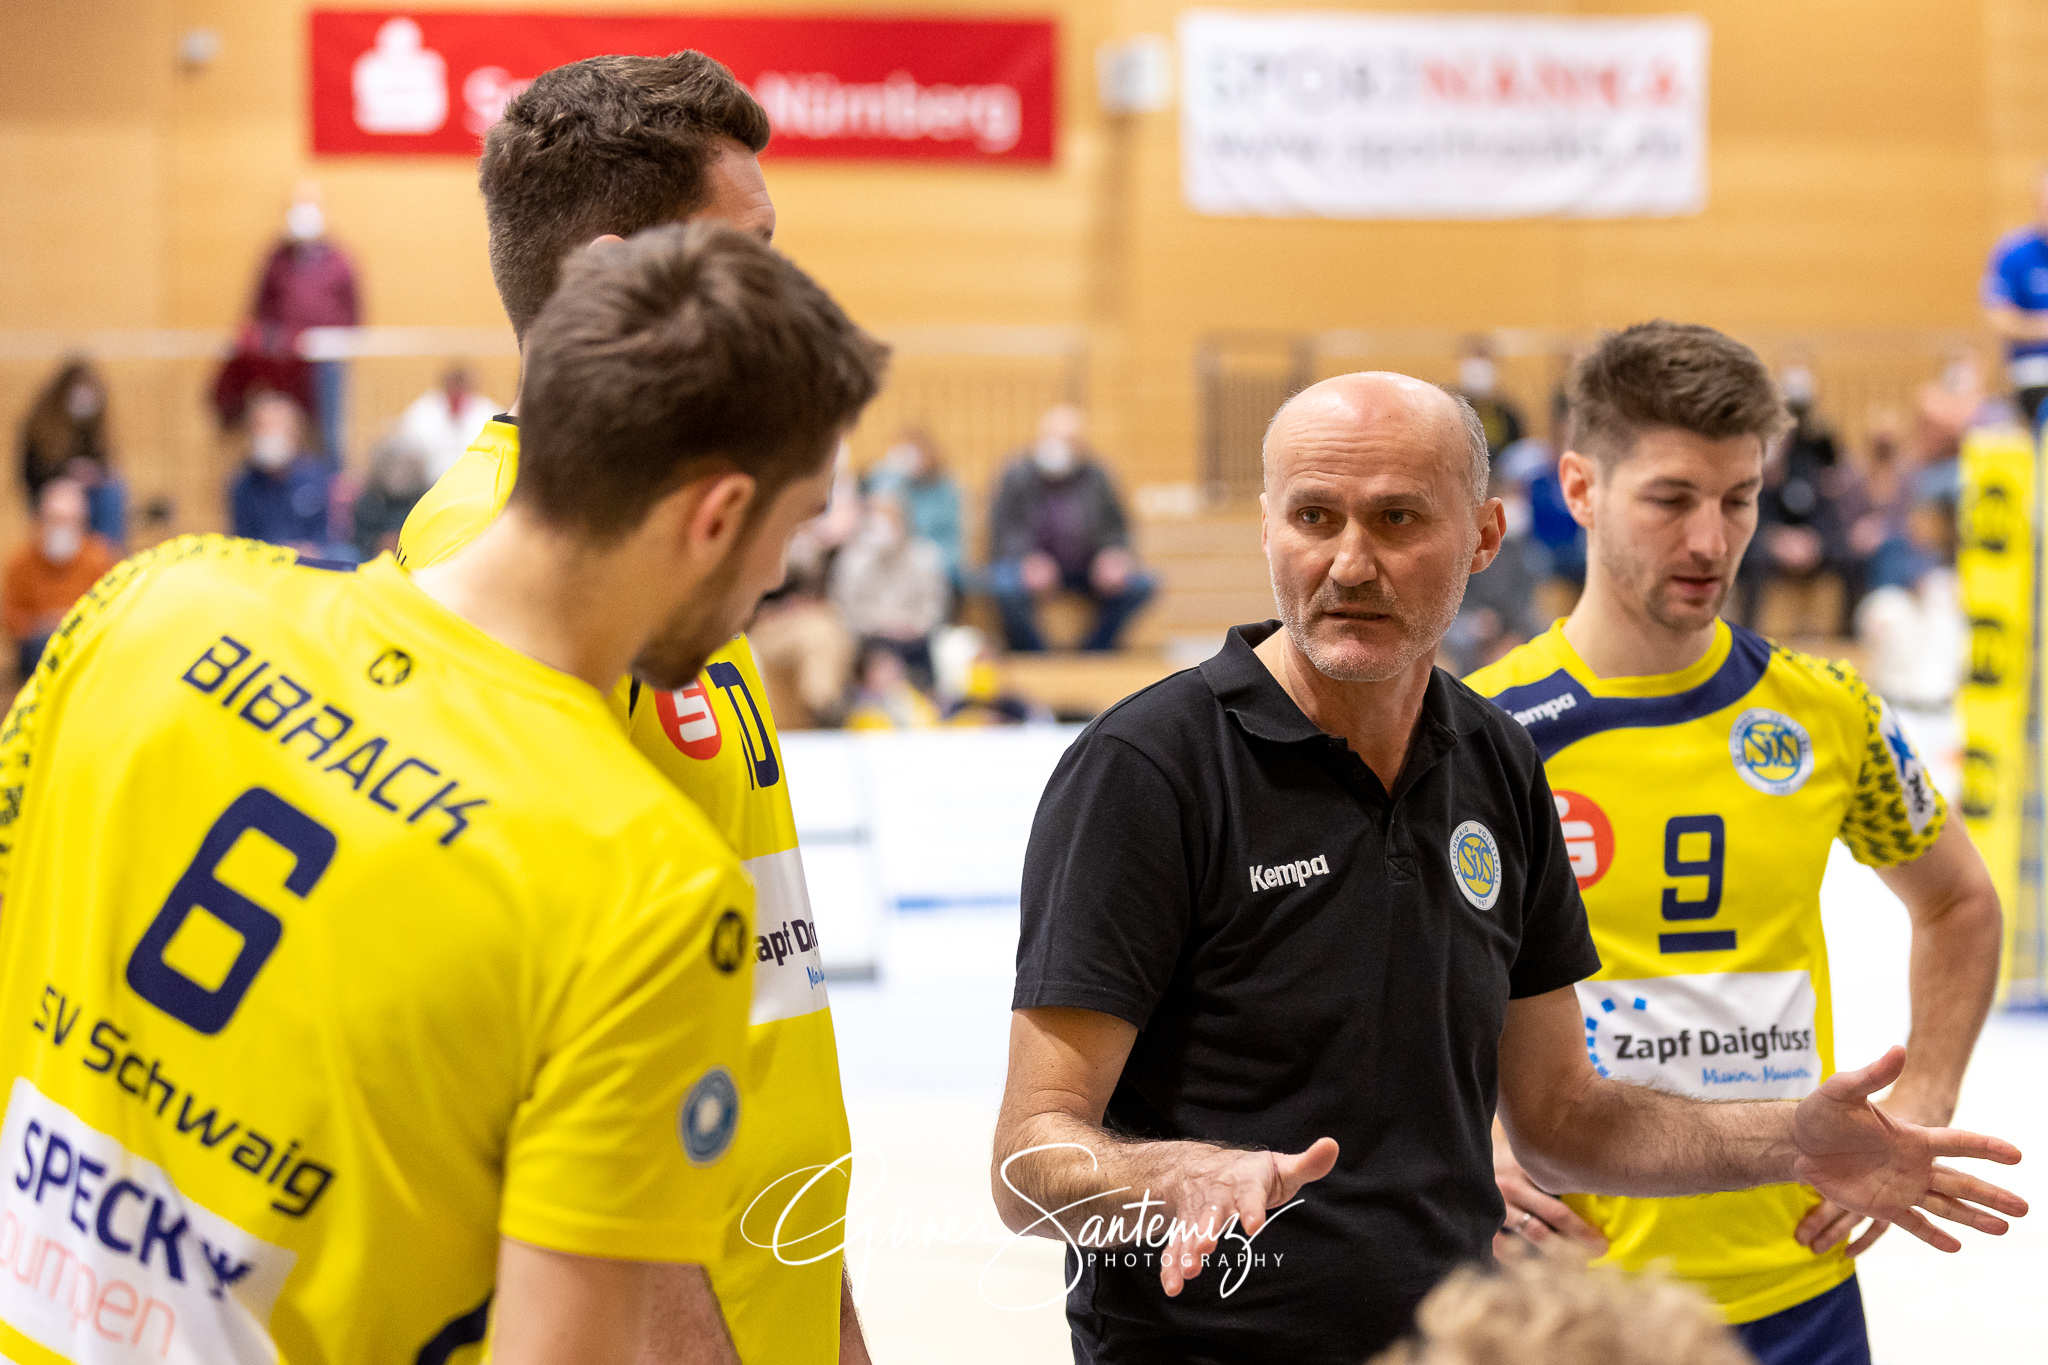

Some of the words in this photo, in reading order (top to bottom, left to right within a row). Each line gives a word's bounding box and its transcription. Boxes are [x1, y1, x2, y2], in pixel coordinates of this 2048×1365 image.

[181, 635, 489, 847] BIBRACK
[1506, 692, 1578, 727] empa
[126, 786, 338, 1037] 6
[1249, 854, 1330, 893] Kempa
[1661, 814, 1726, 922] 9
[753, 920, 794, 967] apf
[1613, 1029, 1691, 1064] Zapf
[33, 984, 83, 1047] SV
[83, 1019, 337, 1221] Schwaig
[15, 1119, 190, 1284] SPECK
